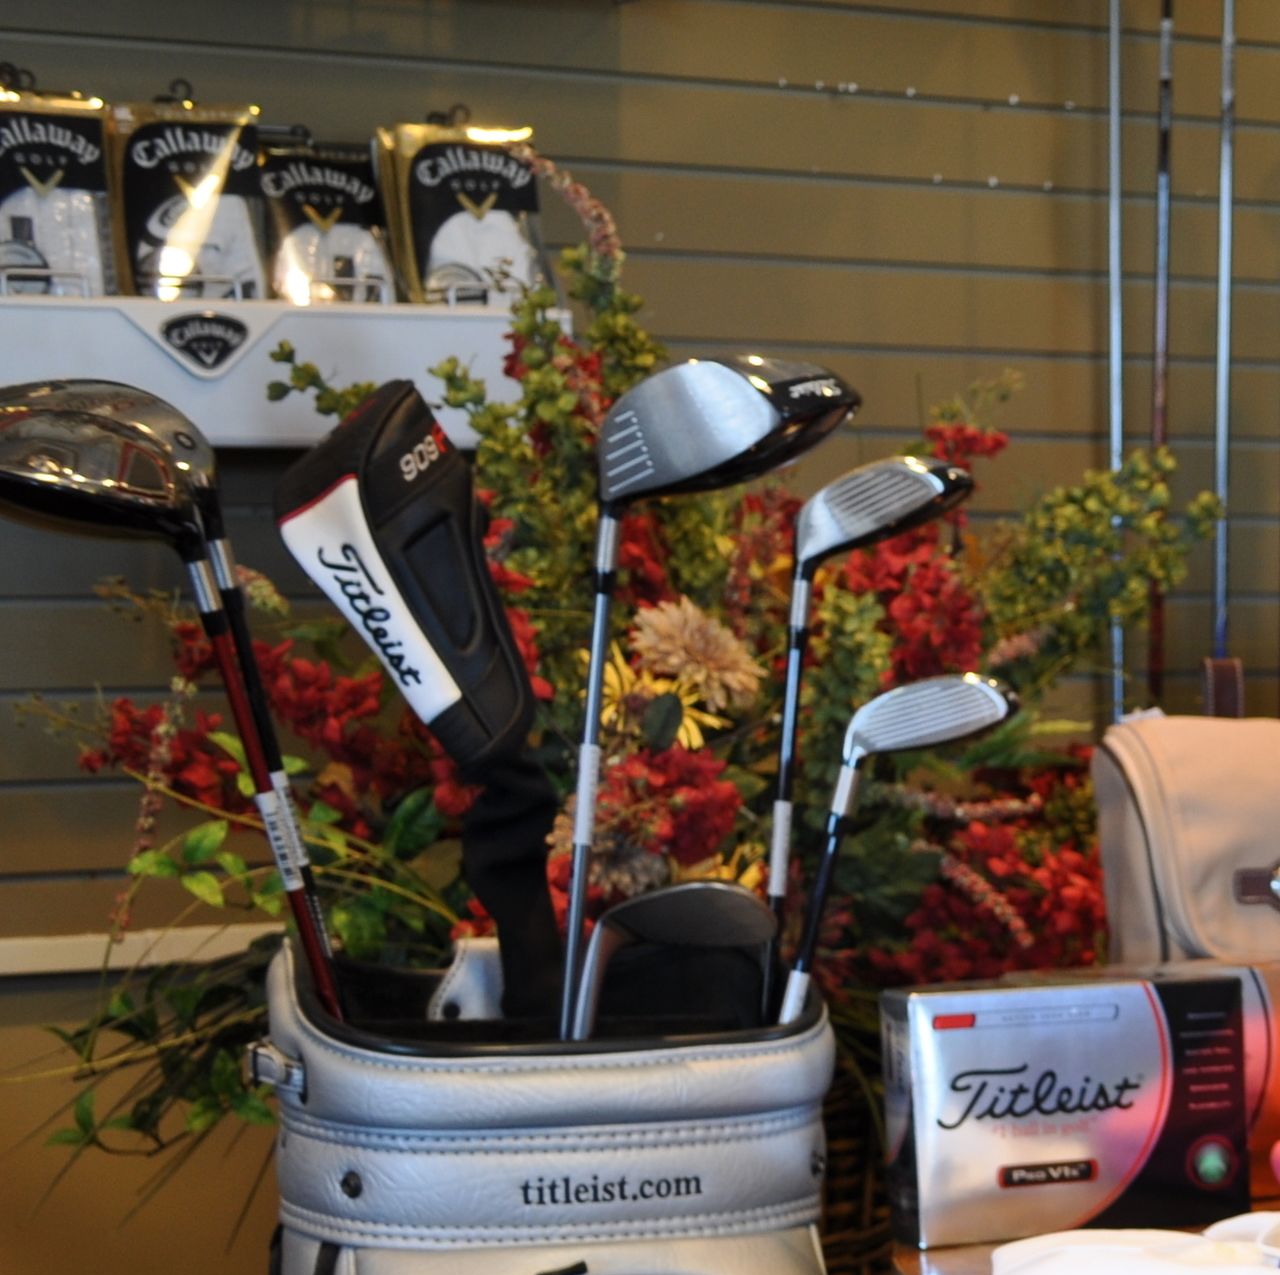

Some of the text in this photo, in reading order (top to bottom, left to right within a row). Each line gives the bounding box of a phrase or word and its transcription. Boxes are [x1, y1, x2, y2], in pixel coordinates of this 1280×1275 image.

[0, 115, 100, 166] allaway
[260, 161, 376, 203] Callaway
[415, 145, 532, 188] Callaway
[318, 543, 422, 688] Titleist
[936, 1063, 1141, 1131] Titleist
[519, 1173, 704, 1206] titleist.com
